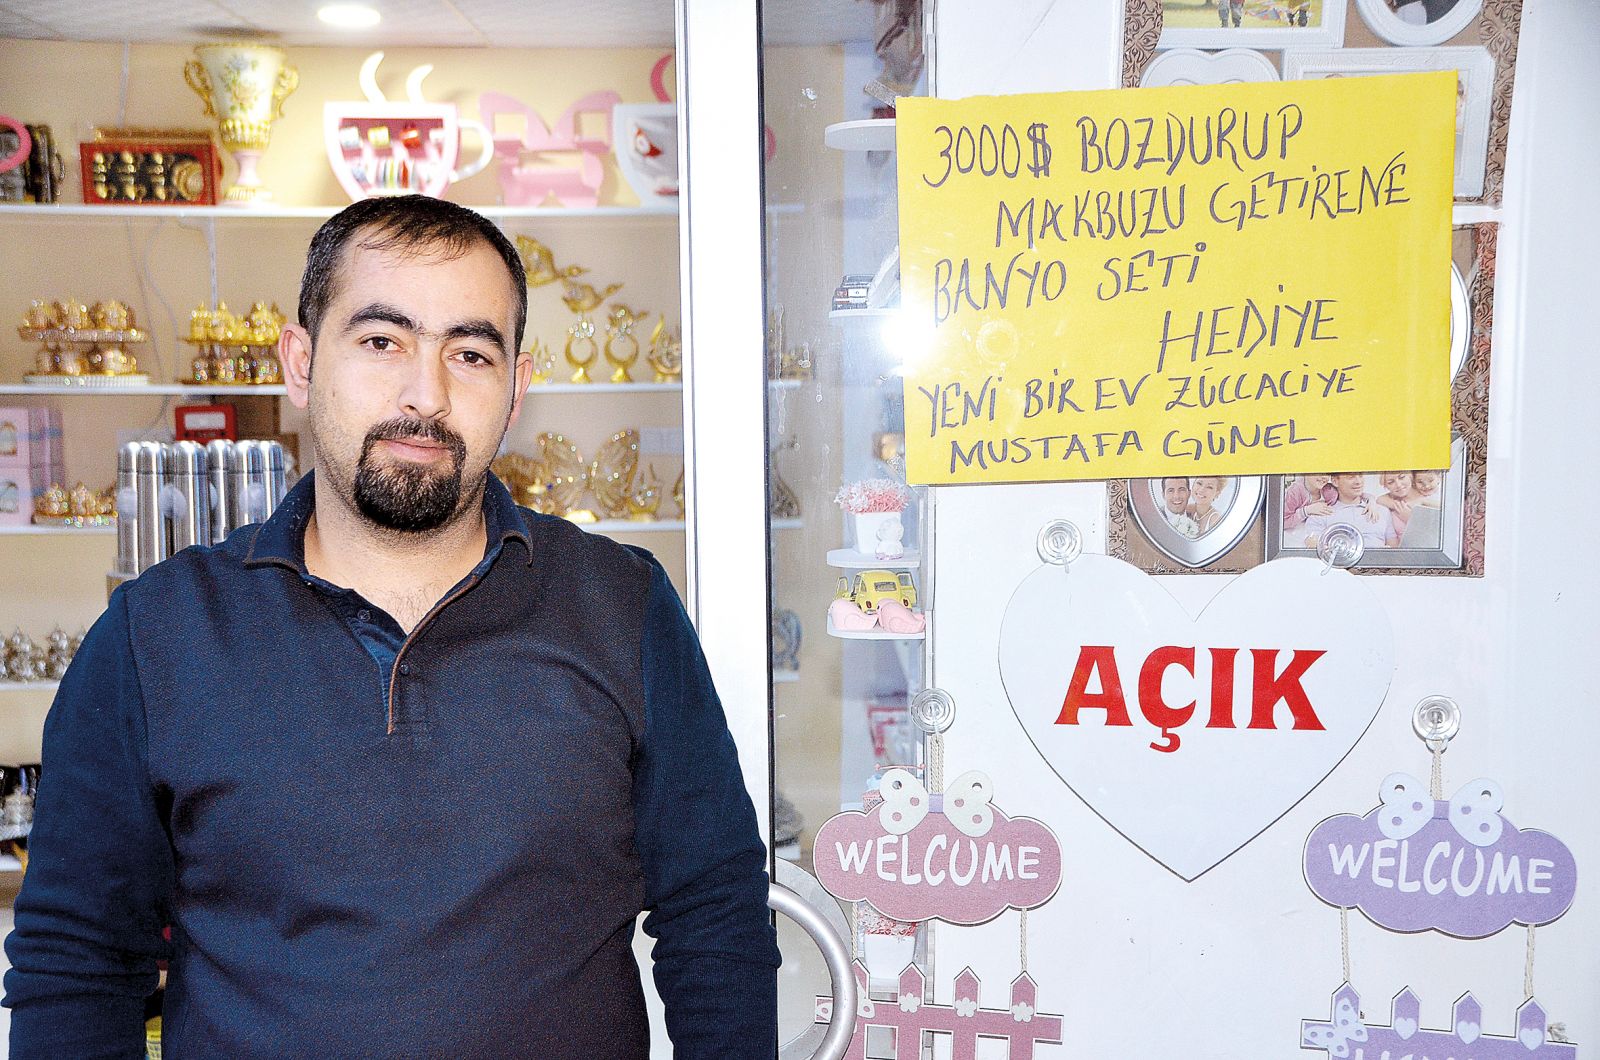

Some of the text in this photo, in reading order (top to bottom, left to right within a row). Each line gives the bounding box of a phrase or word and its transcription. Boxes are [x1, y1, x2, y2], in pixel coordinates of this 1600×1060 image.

[922, 103, 1303, 188] 3000$ BOZDURUP
[996, 151, 1411, 249] MAKBUZU GETİRENE
[933, 241, 1207, 328] BANYO SETİ
[1156, 284, 1339, 374] HEDİYE
[918, 374, 1004, 438] YENİ
[1023, 368, 1085, 419] BİR
[1094, 373, 1151, 412] EV
[949, 417, 1317, 475] MUSTAFA GÜNEL
[1054, 645, 1327, 753] AÇIK
